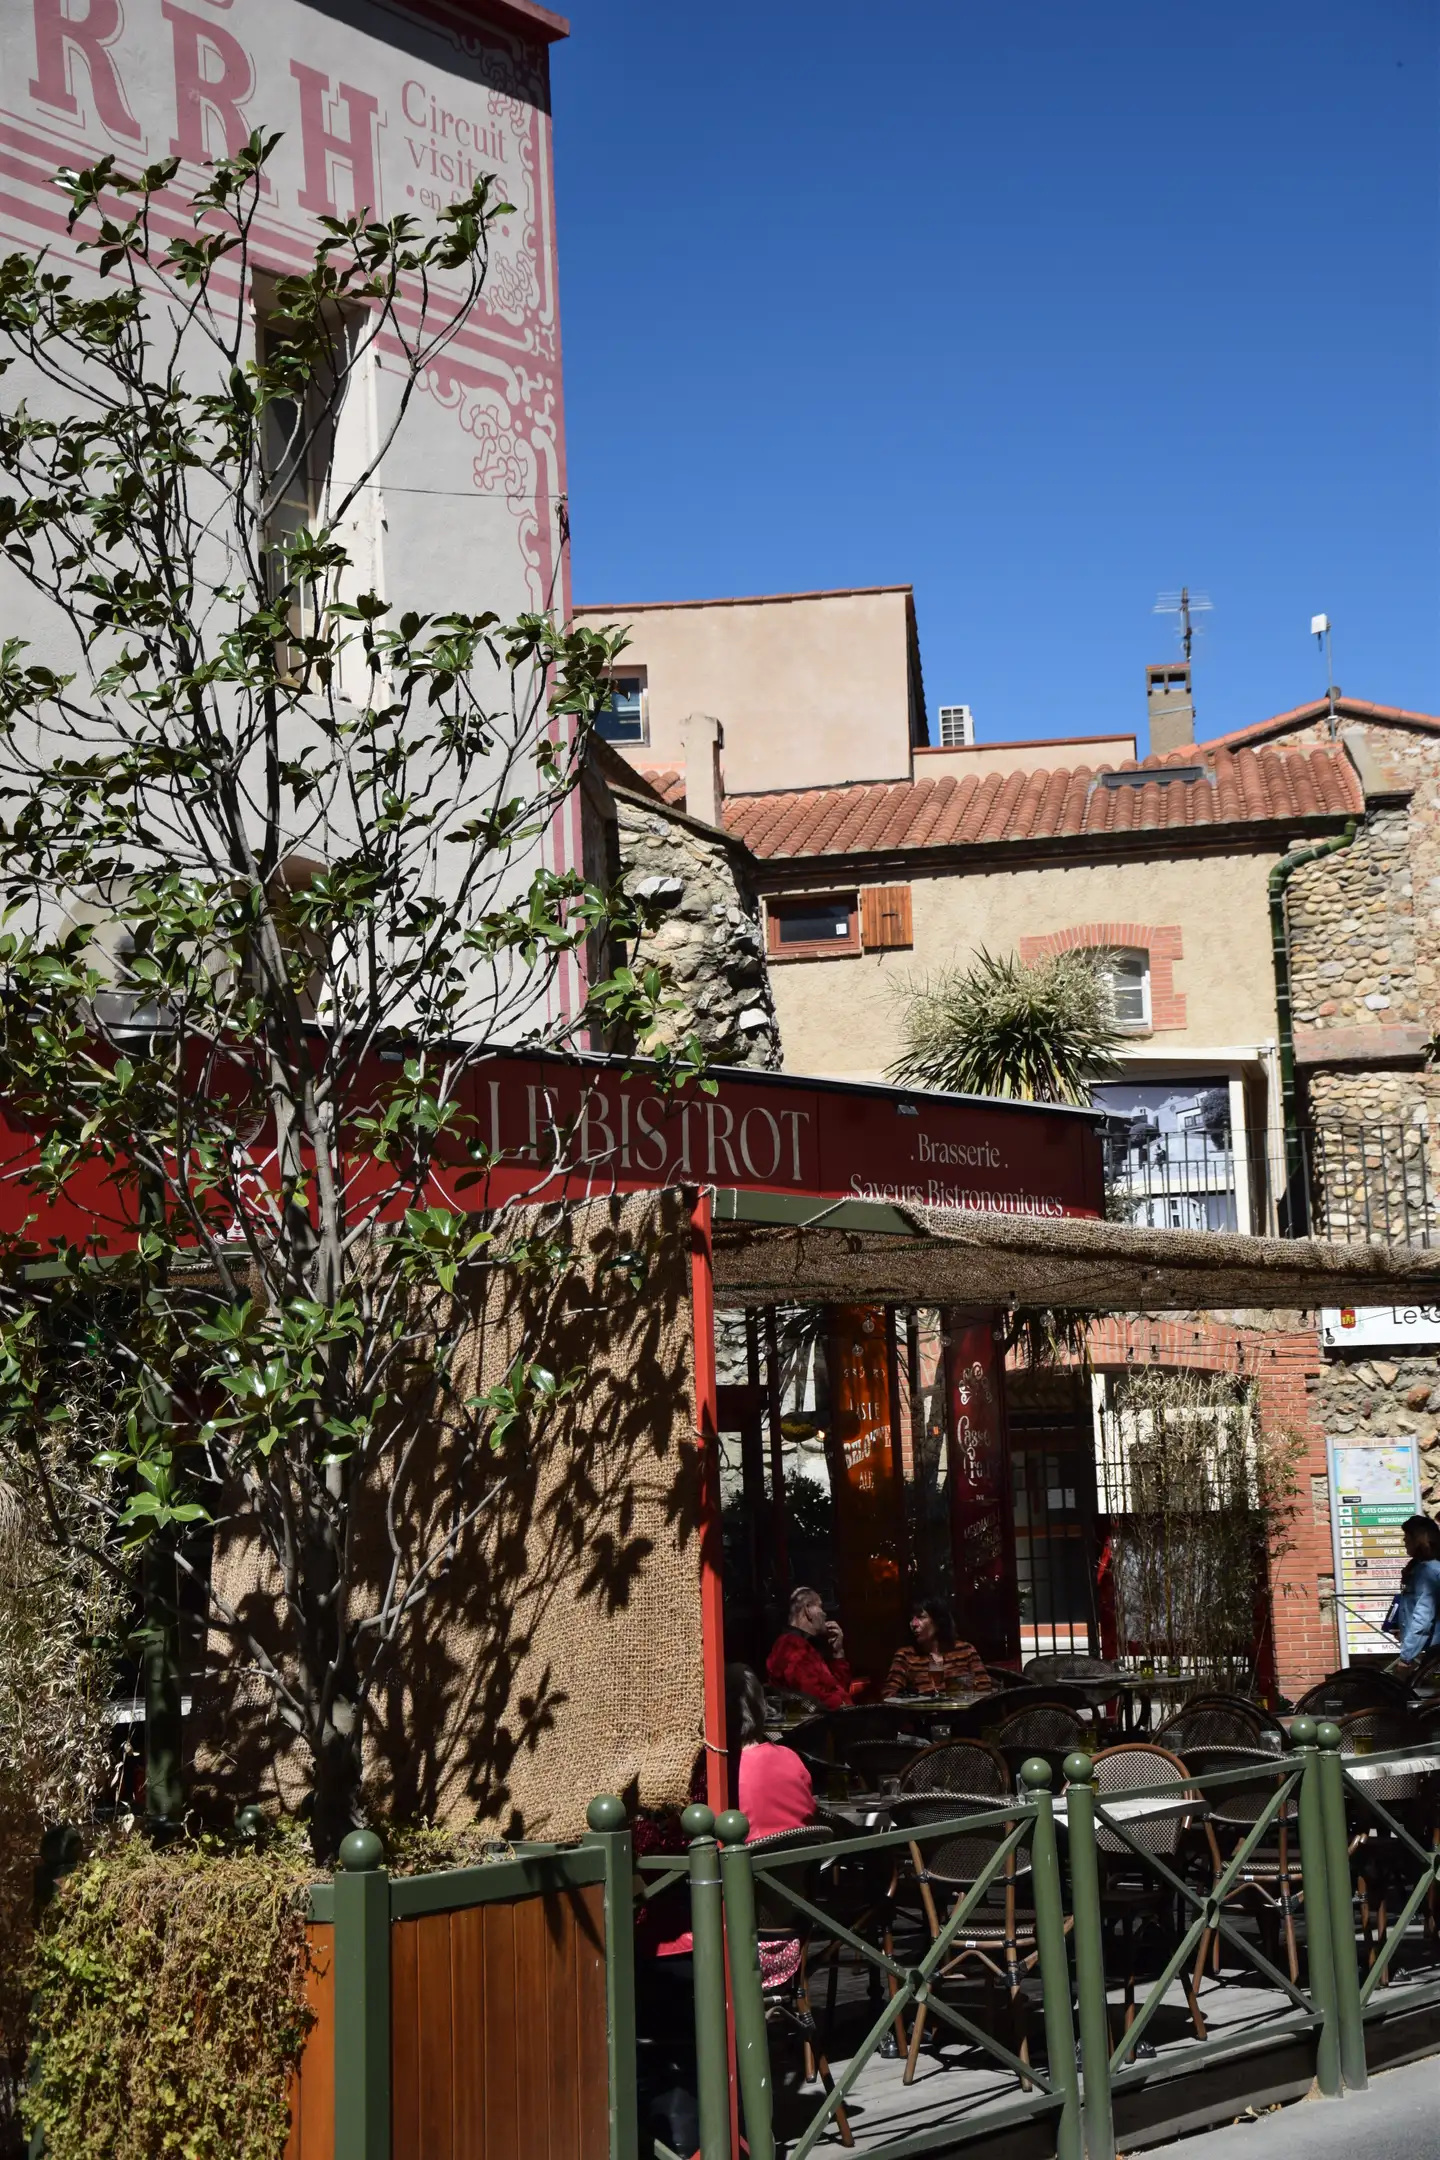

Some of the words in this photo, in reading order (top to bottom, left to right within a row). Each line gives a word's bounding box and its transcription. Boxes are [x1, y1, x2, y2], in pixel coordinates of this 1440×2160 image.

[401, 79, 508, 164] Circuit
[578, 1089, 810, 1182] BISTROT
[917, 1132, 1001, 1169] Brasserie
[850, 1173, 924, 1206] Saveurs
[927, 1178, 1064, 1217] Bistronomiques
[1392, 1306, 1418, 1325] Le
